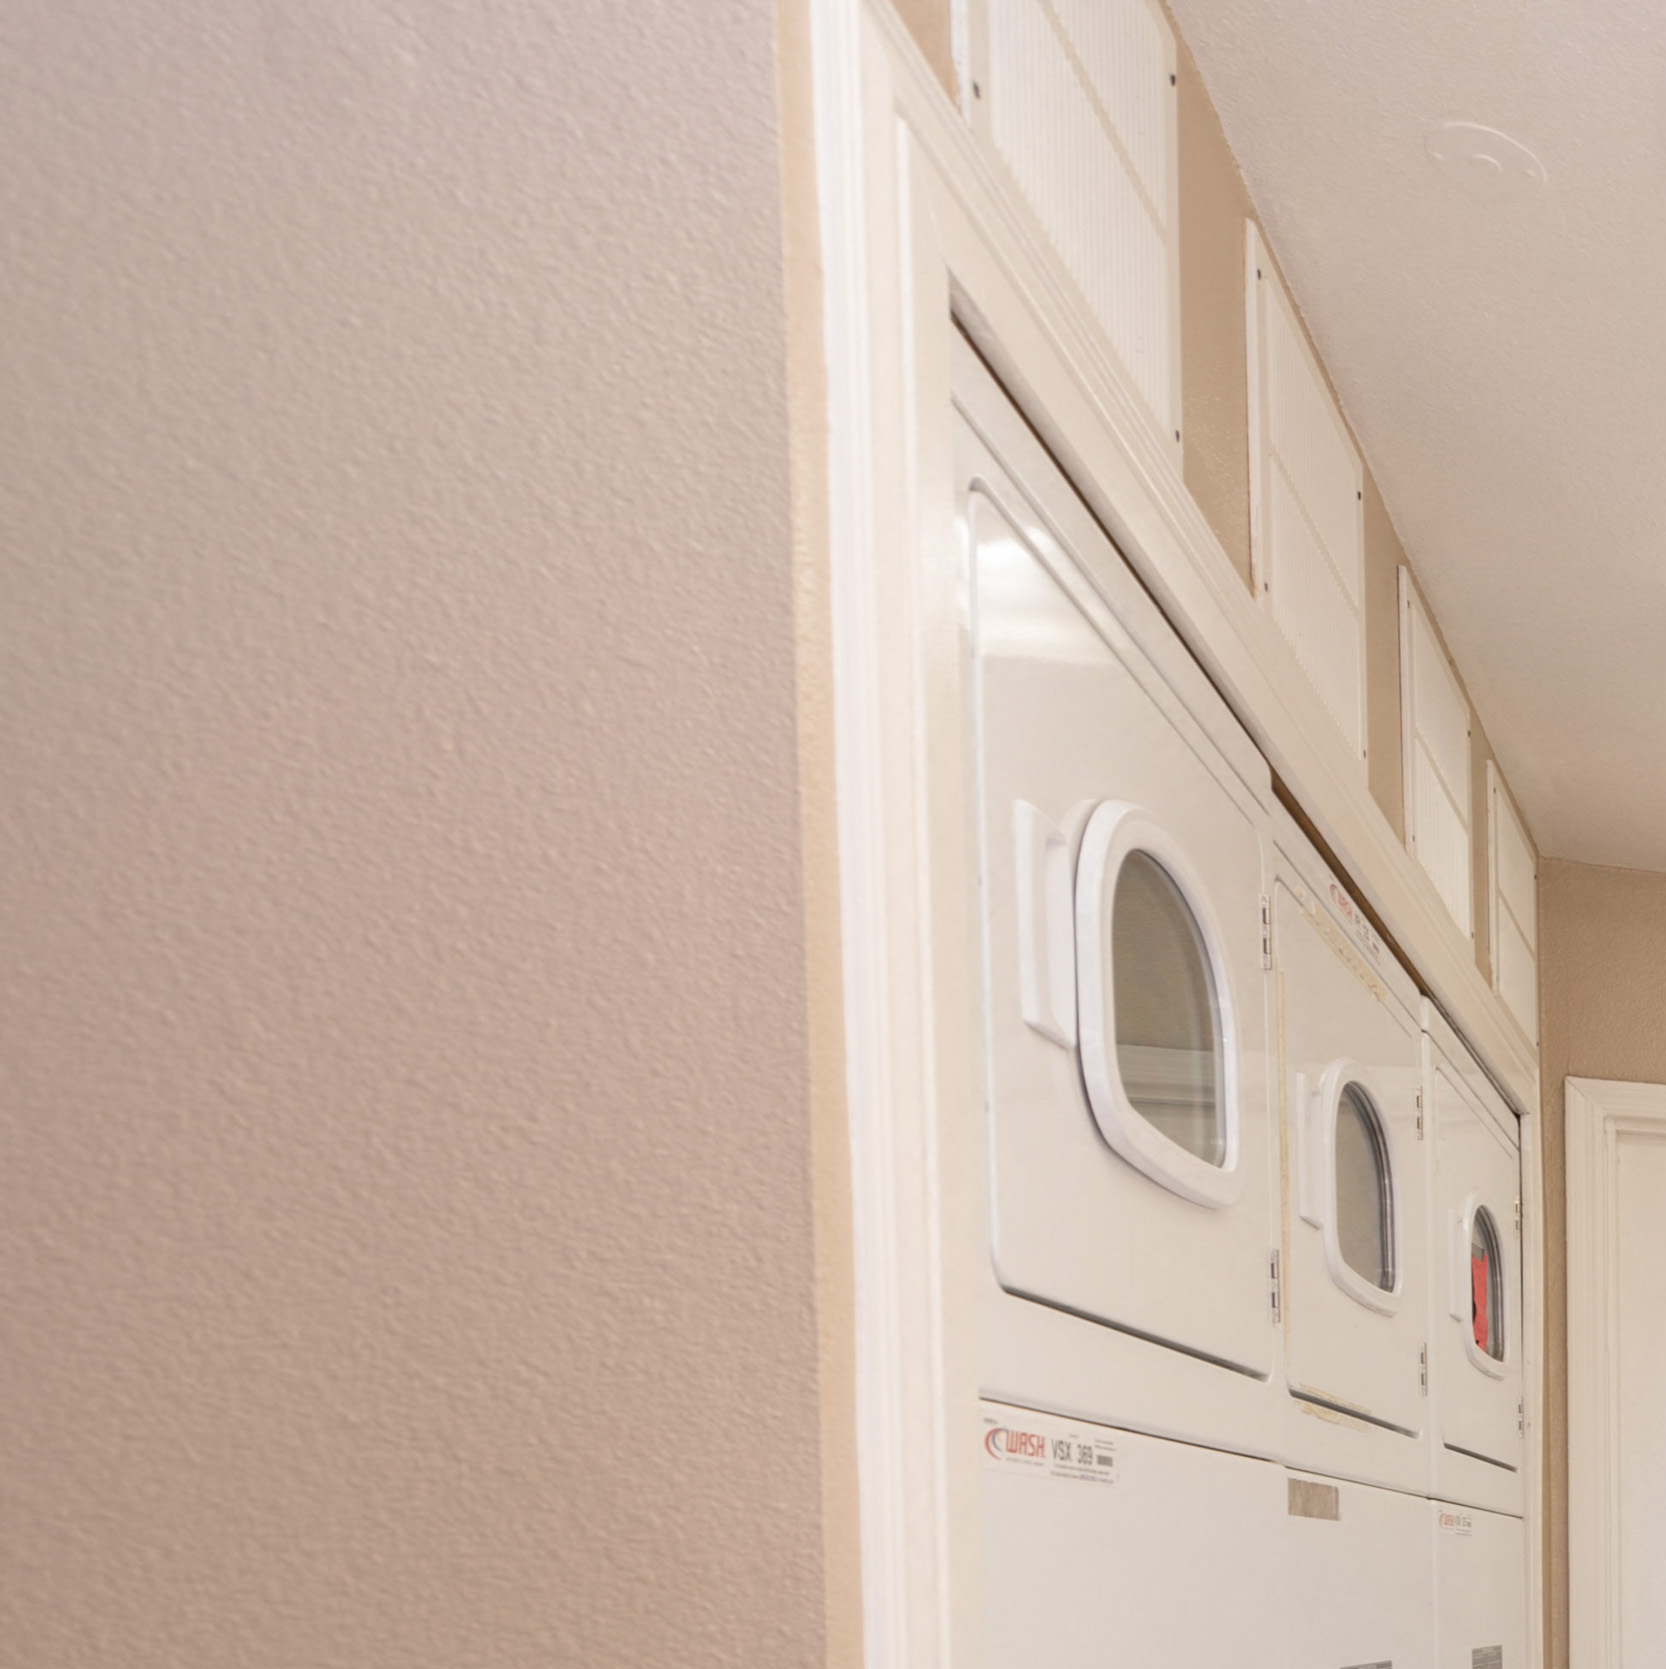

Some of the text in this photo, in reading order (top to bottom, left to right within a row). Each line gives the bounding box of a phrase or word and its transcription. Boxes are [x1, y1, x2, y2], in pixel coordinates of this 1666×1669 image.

[1006, 1430, 1046, 1458] WASH
[1051, 1438, 1072, 1463] VSX
[1077, 1443, 1093, 1466] 369
